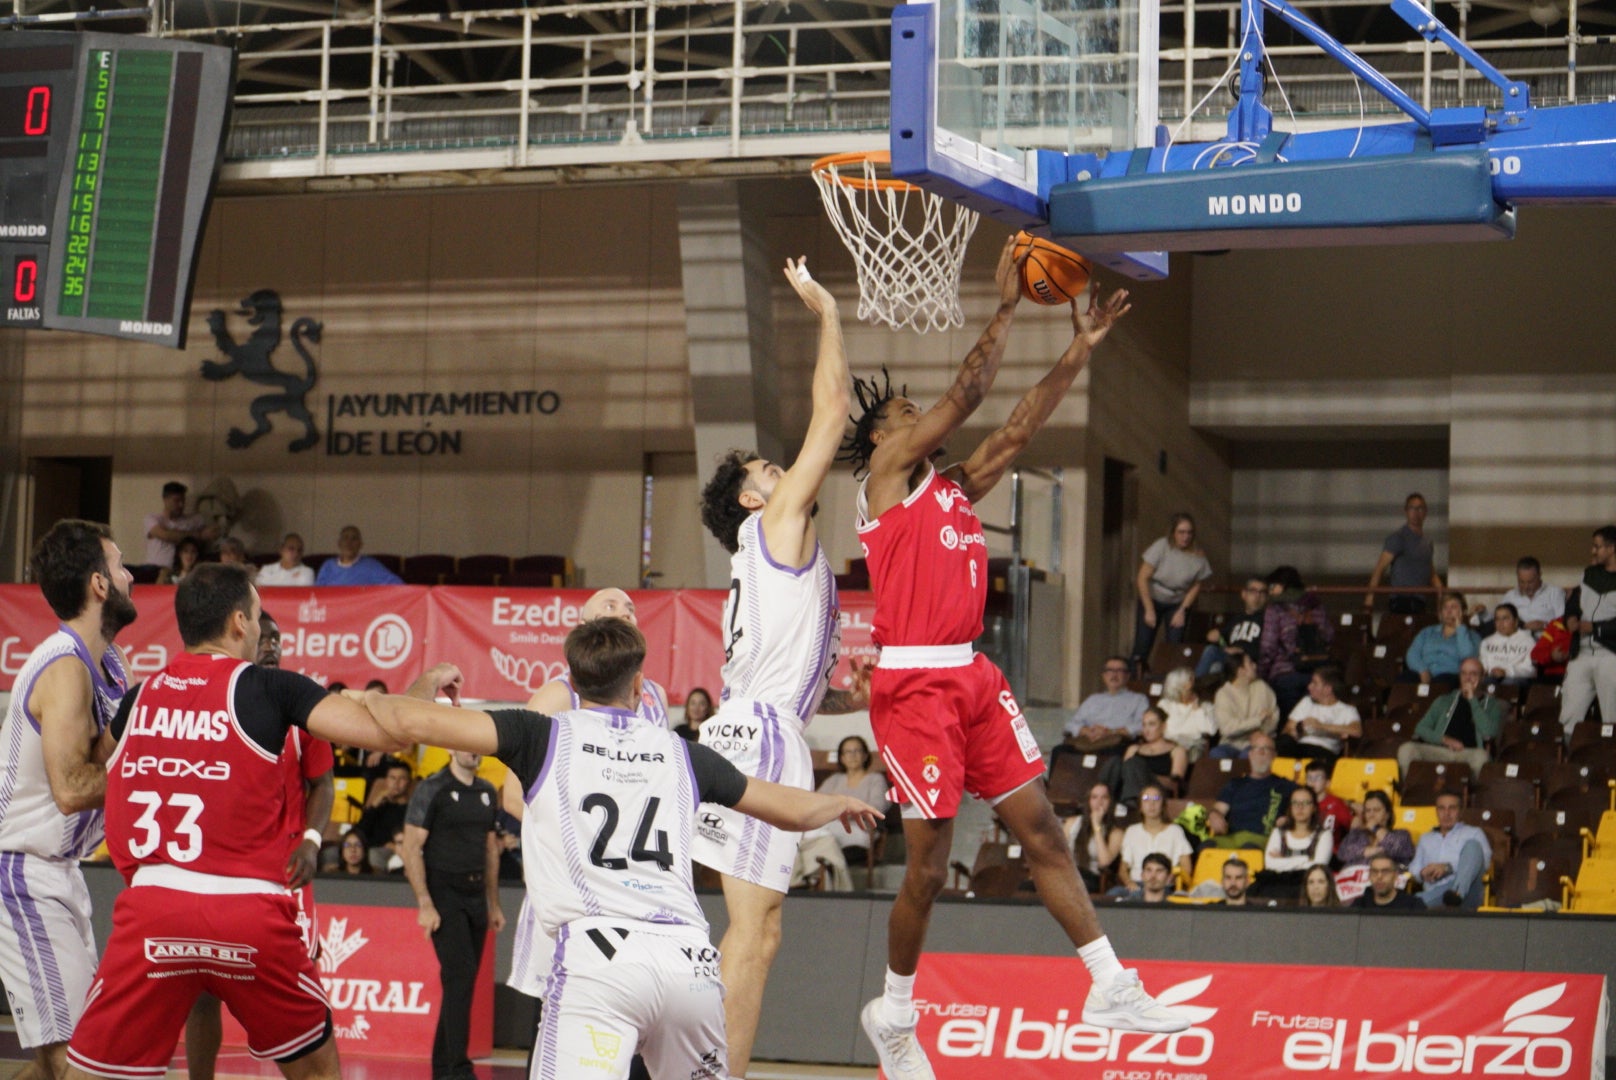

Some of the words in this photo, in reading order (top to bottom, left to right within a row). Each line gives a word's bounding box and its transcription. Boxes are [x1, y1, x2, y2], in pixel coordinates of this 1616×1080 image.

[100, 51, 111, 68] E
[98, 71, 108, 89] 5
[95, 91, 106, 109] 6
[24, 86, 50, 135] 0
[95, 112, 104, 129] 7
[80, 132, 102, 150] 11
[77, 153, 99, 171] 13
[74, 174, 97, 191] 14
[72, 194, 93, 212] 15
[1208, 193, 1302, 215] MONDO
[0, 225, 47, 237] MONDO
[69, 215, 90, 233] 16
[67, 236, 89, 253] 22
[65, 256, 86, 274] 24
[14, 260, 37, 302] 0
[63, 276, 83, 295] 35
[7, 308, 40, 320] FALTAS
[120, 321, 173, 335] MONDO
[336, 390, 561, 417] AYUNTAMIENTO
[333, 431, 373, 456] DE
[380, 422, 462, 456] LEÓN
[492, 596, 583, 627] Ezede
[280, 628, 359, 657] clerc
[541, 633, 566, 645] Desi
[998, 690, 1020, 718] 6
[129, 705, 230, 742] LLAMAS
[707, 724, 758, 740] VICKY
[582, 743, 666, 764] BELLVER
[128, 789, 205, 863] 33
[579, 792, 674, 872] 24
[913, 999, 988, 1017] Frutas
[1252, 1010, 1335, 1029] Frutas
[937, 1007, 1000, 1058] el
[1004, 1008, 1215, 1066] bierzo
[1283, 1019, 1347, 1072] el
[1354, 1019, 1574, 1077] bierzo
